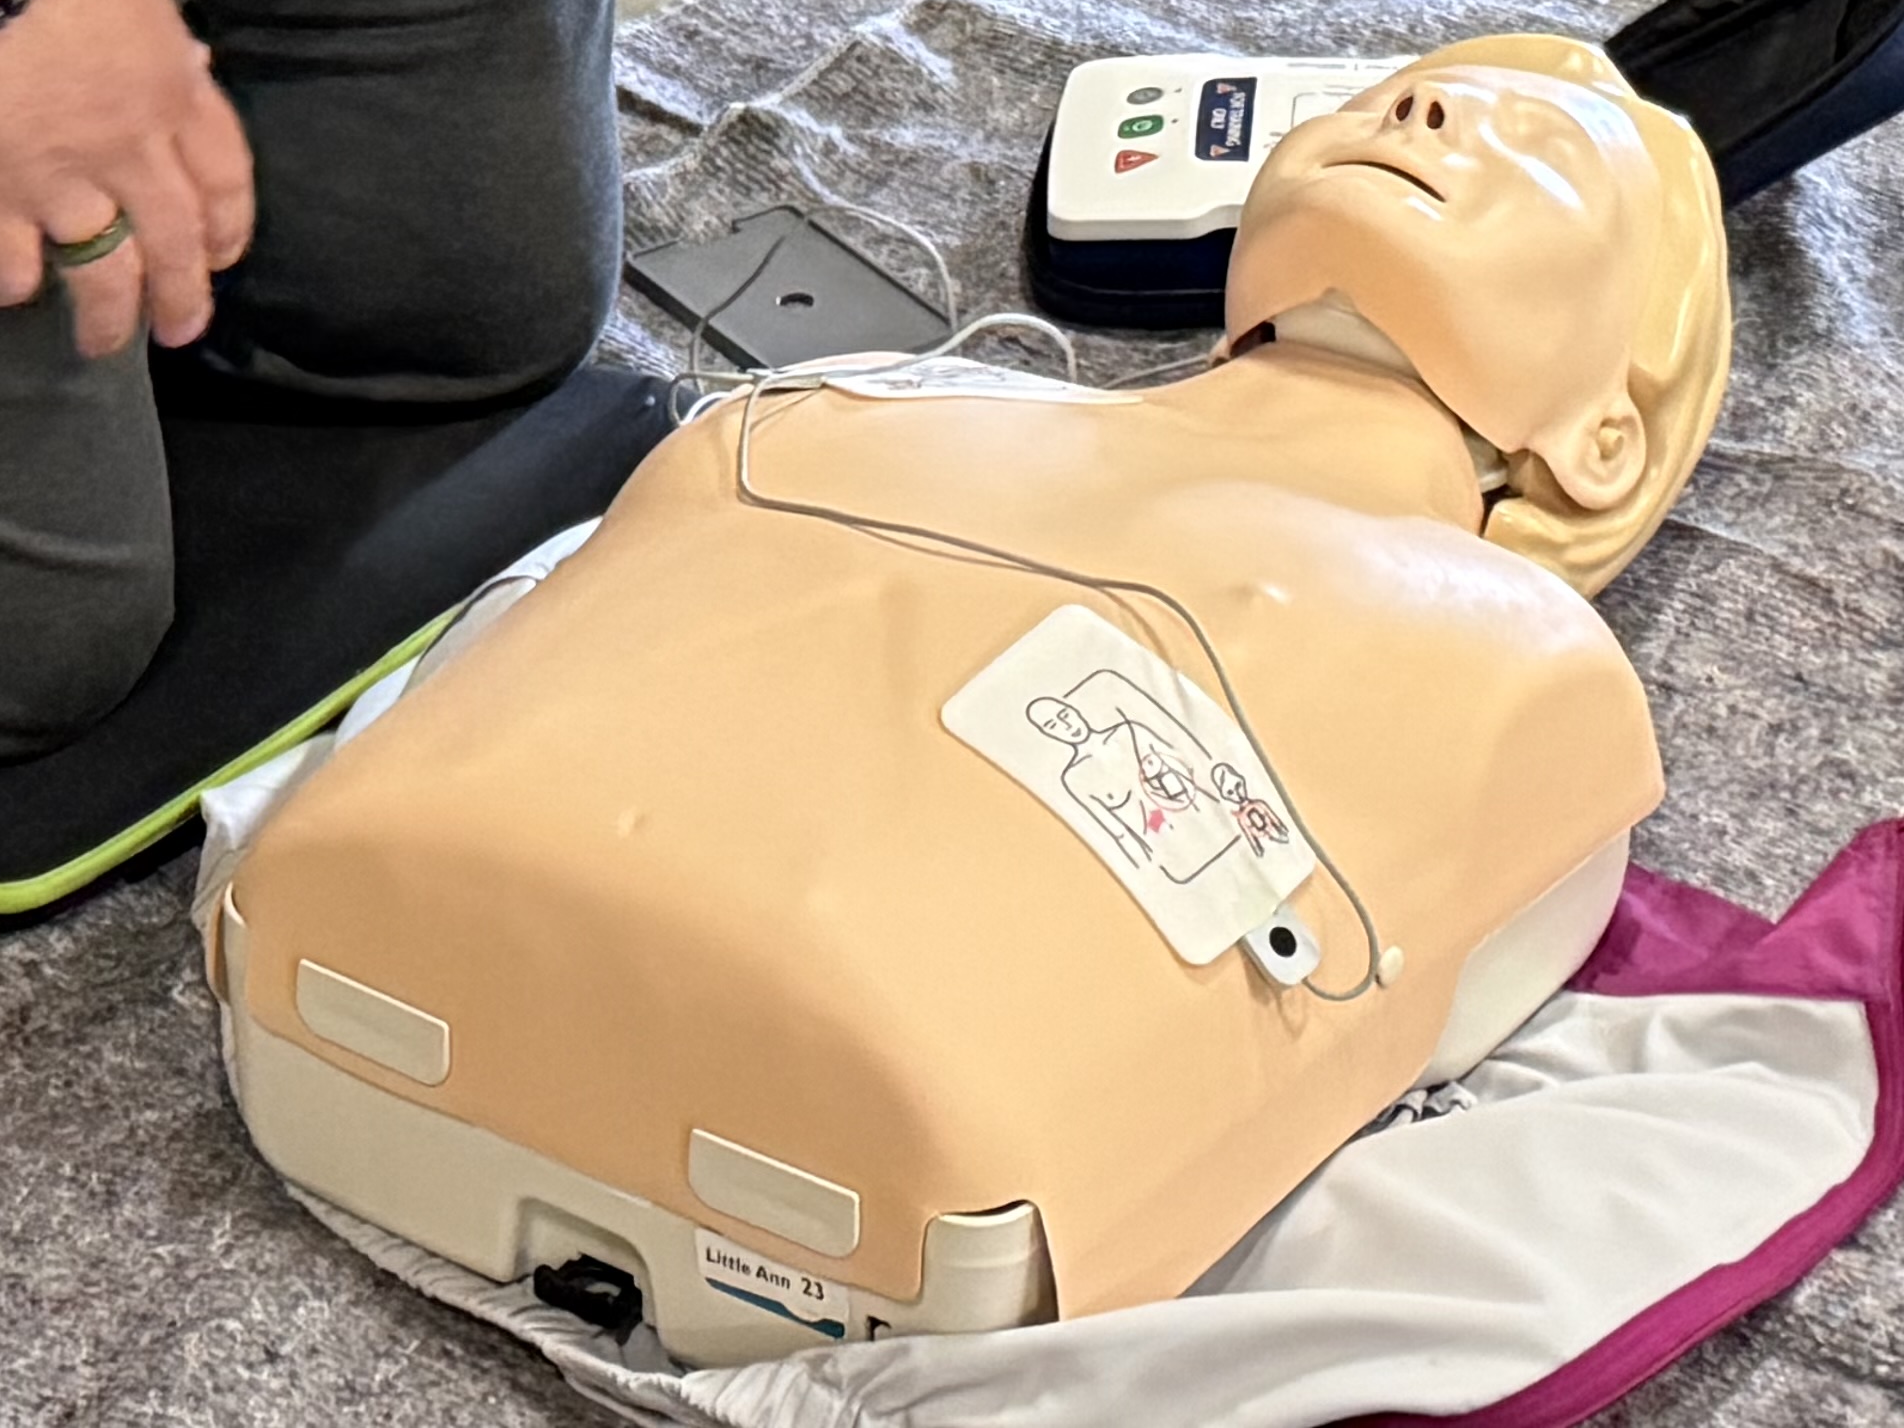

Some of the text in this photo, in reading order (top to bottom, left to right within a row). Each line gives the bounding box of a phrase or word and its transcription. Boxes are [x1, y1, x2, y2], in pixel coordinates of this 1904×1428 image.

[706, 1246, 825, 1301] Little Ann 23
